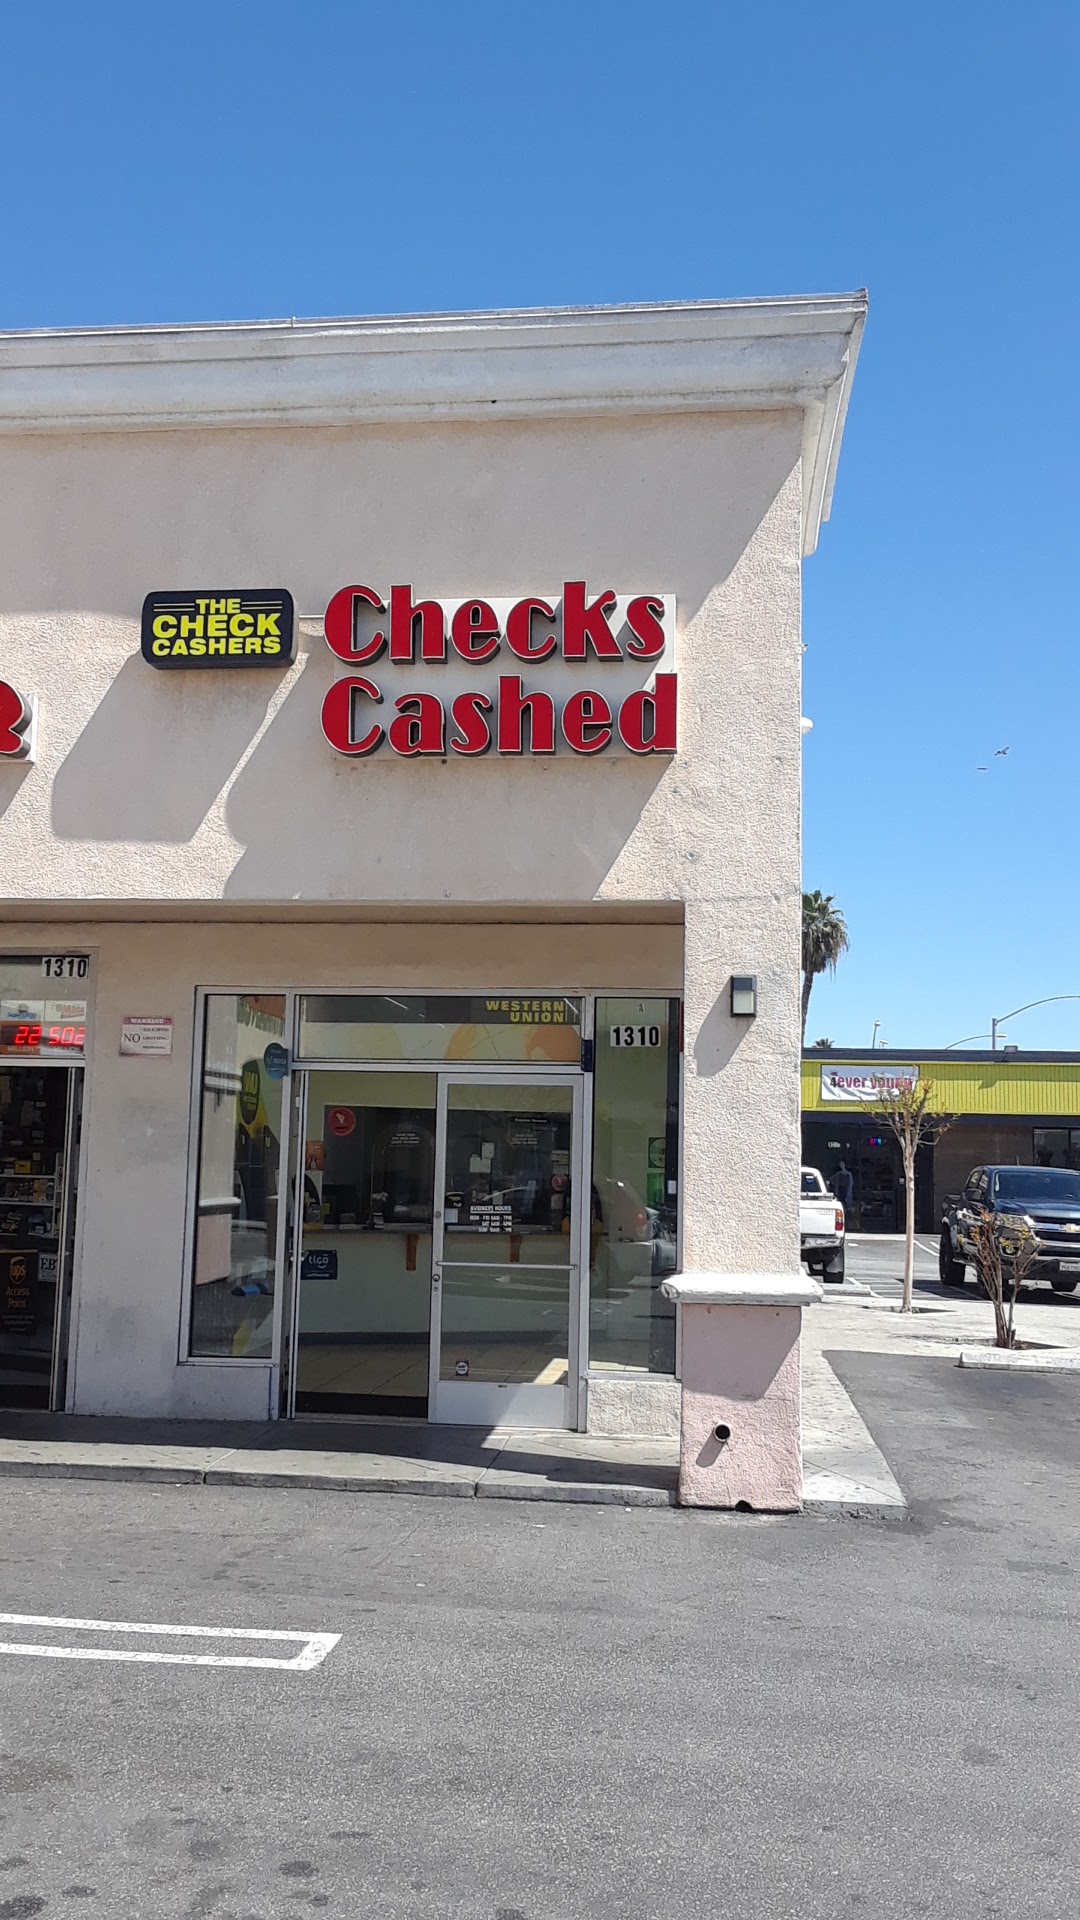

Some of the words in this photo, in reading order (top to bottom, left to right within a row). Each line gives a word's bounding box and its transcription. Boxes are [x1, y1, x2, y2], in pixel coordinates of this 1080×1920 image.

[195, 598, 241, 614] THE
[152, 612, 281, 638] CHECK
[323, 580, 666, 662] Checks
[152, 636, 281, 656] CASHERS
[321, 672, 678, 755] Cashed
[44, 958, 87, 977] 1310
[485, 1000, 564, 1012] WESTERN
[509, 1012, 564, 1023] UNION
[14, 1026, 42, 1045] 22
[123, 1033, 141, 1043] NO
[612, 1025, 660, 1047] 1310
[11, 1264, 26, 1280] ups
[6, 1286, 30, 1296] Access
